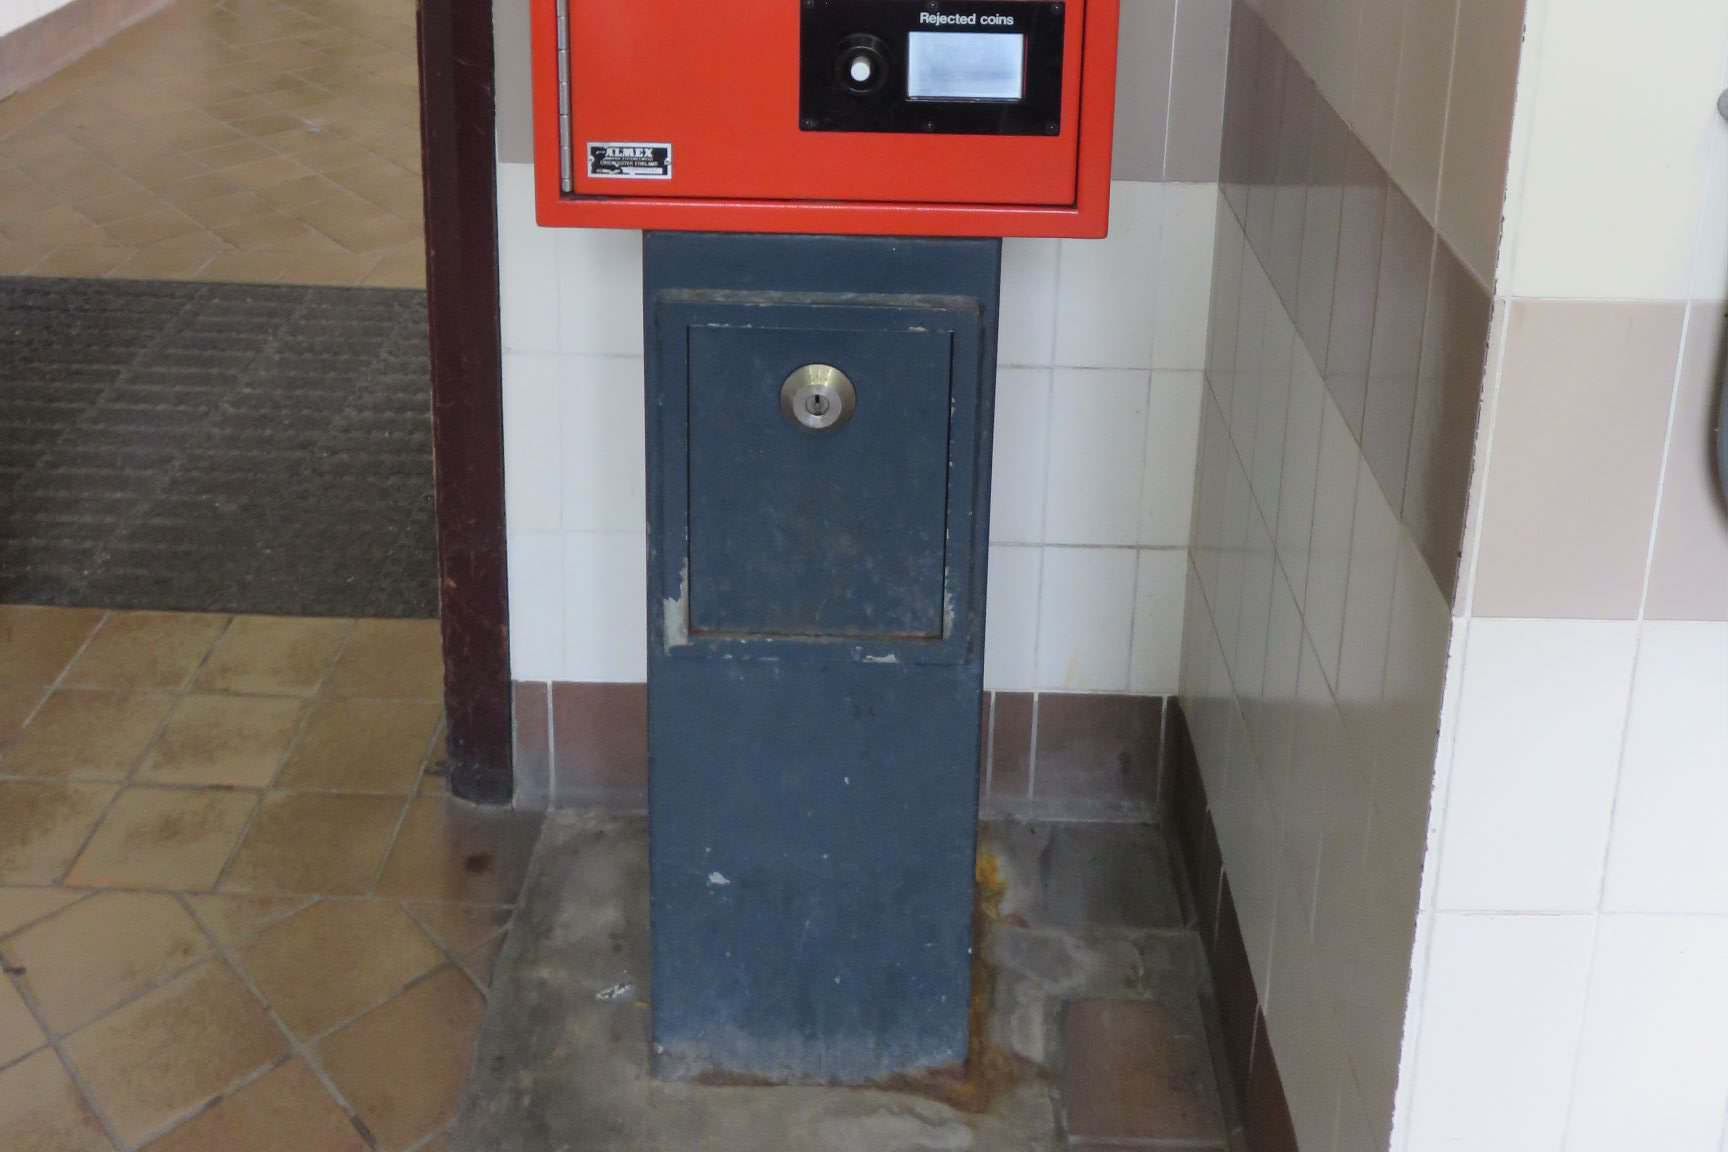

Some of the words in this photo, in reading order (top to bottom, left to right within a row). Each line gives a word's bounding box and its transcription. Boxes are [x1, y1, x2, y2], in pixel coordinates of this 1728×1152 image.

[920, 12, 976, 26] Rejected
[980, 13, 1014, 25] coins
[605, 147, 653, 157] ALMEX
